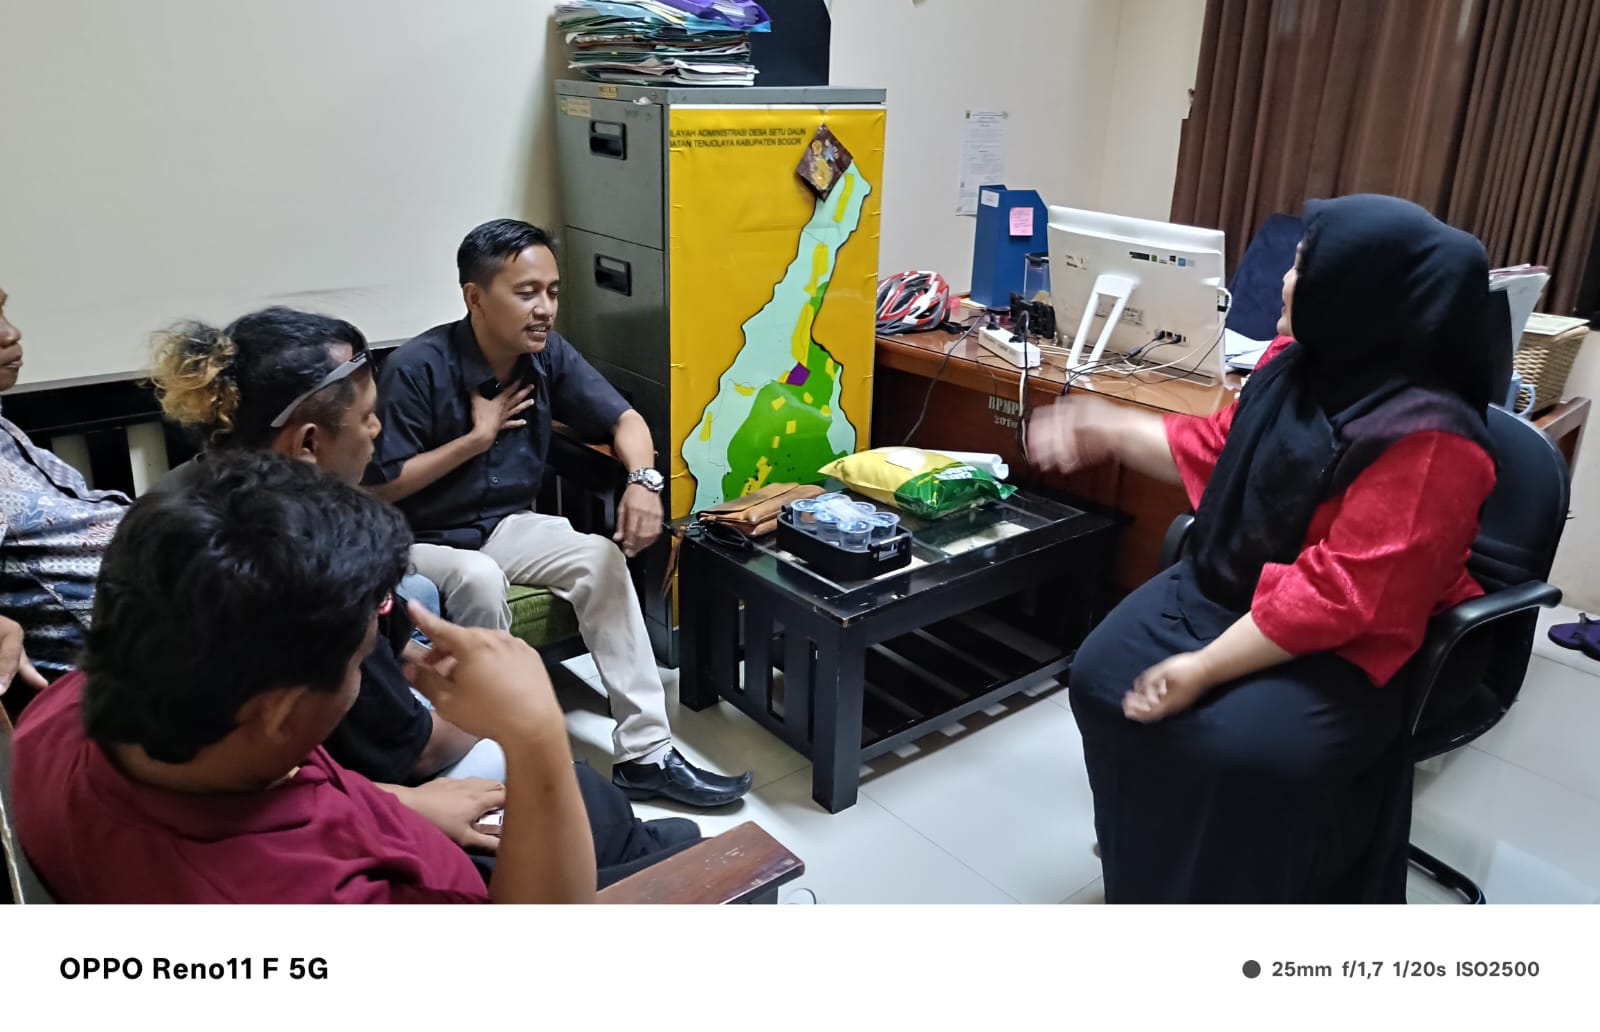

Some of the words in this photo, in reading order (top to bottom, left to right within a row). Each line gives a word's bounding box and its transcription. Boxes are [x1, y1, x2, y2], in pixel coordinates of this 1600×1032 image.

[698, 128, 747, 137] ADMINISTRASI
[748, 128, 767, 136] DESA
[769, 128, 786, 136] SETU
[787, 128, 806, 136] DAUN
[736, 138, 776, 146] KABUPATEN
[777, 137, 801, 146] BOGOR
